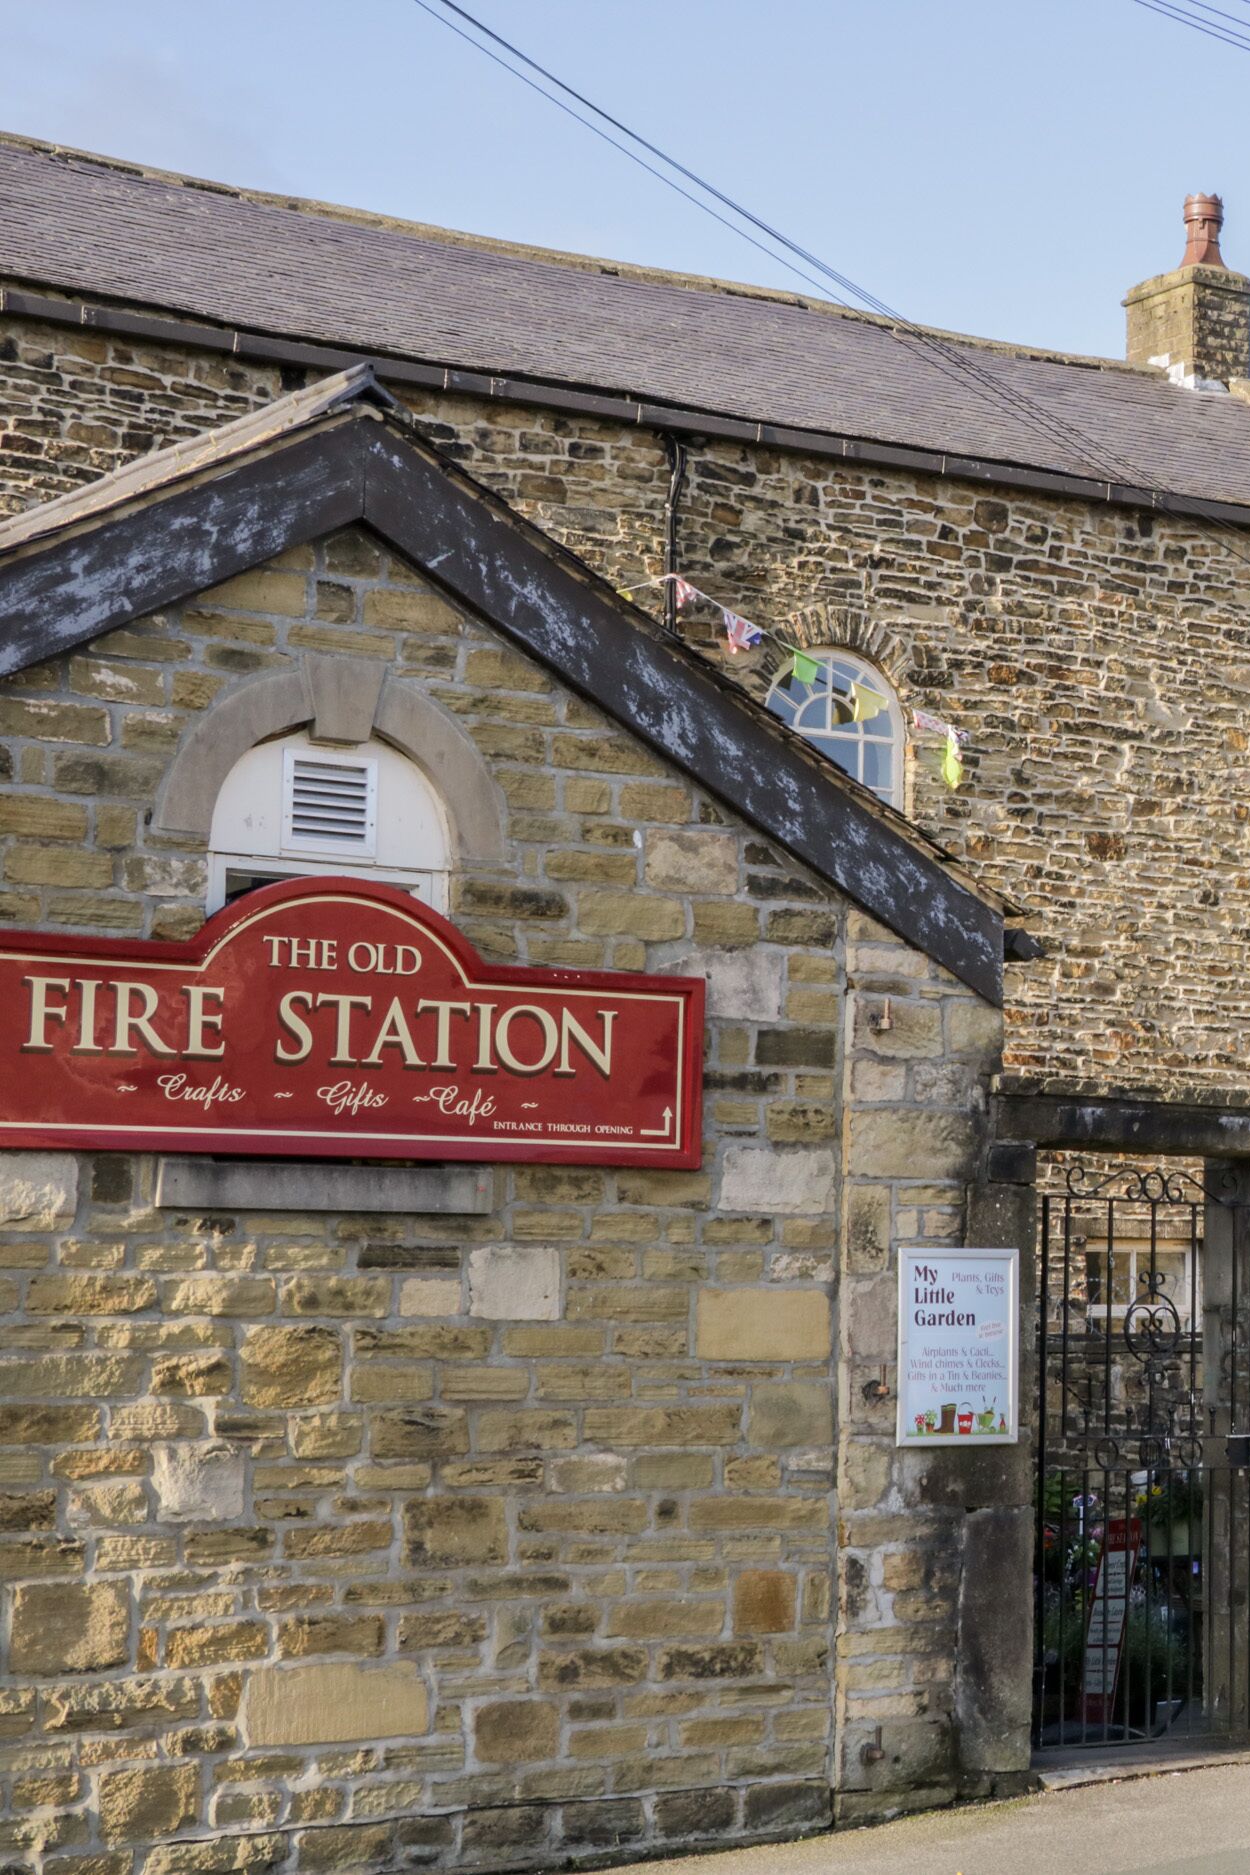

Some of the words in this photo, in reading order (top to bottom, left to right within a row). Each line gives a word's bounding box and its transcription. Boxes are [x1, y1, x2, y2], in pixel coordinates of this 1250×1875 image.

[263, 935, 338, 970] THE
[347, 942, 423, 975] OLD
[22, 976, 226, 1057] FIRE
[275, 990, 618, 1080] STATION
[157, 1073, 246, 1110] Crafts
[316, 1081, 389, 1115] Gifts
[429, 1085, 497, 1126] Café
[493, 1121, 543, 1132] ENTRANCE
[547, 1123, 591, 1134] THROUGH
[595, 1126, 633, 1135] OPENING
[914, 1265, 938, 1286] My
[951, 1271, 982, 1283] Plants,
[984, 1271, 1005, 1283] Gifts
[914, 1287, 955, 1304] Little
[914, 1309, 976, 1326] Garden
[910, 1359, 933, 1369] Wind
